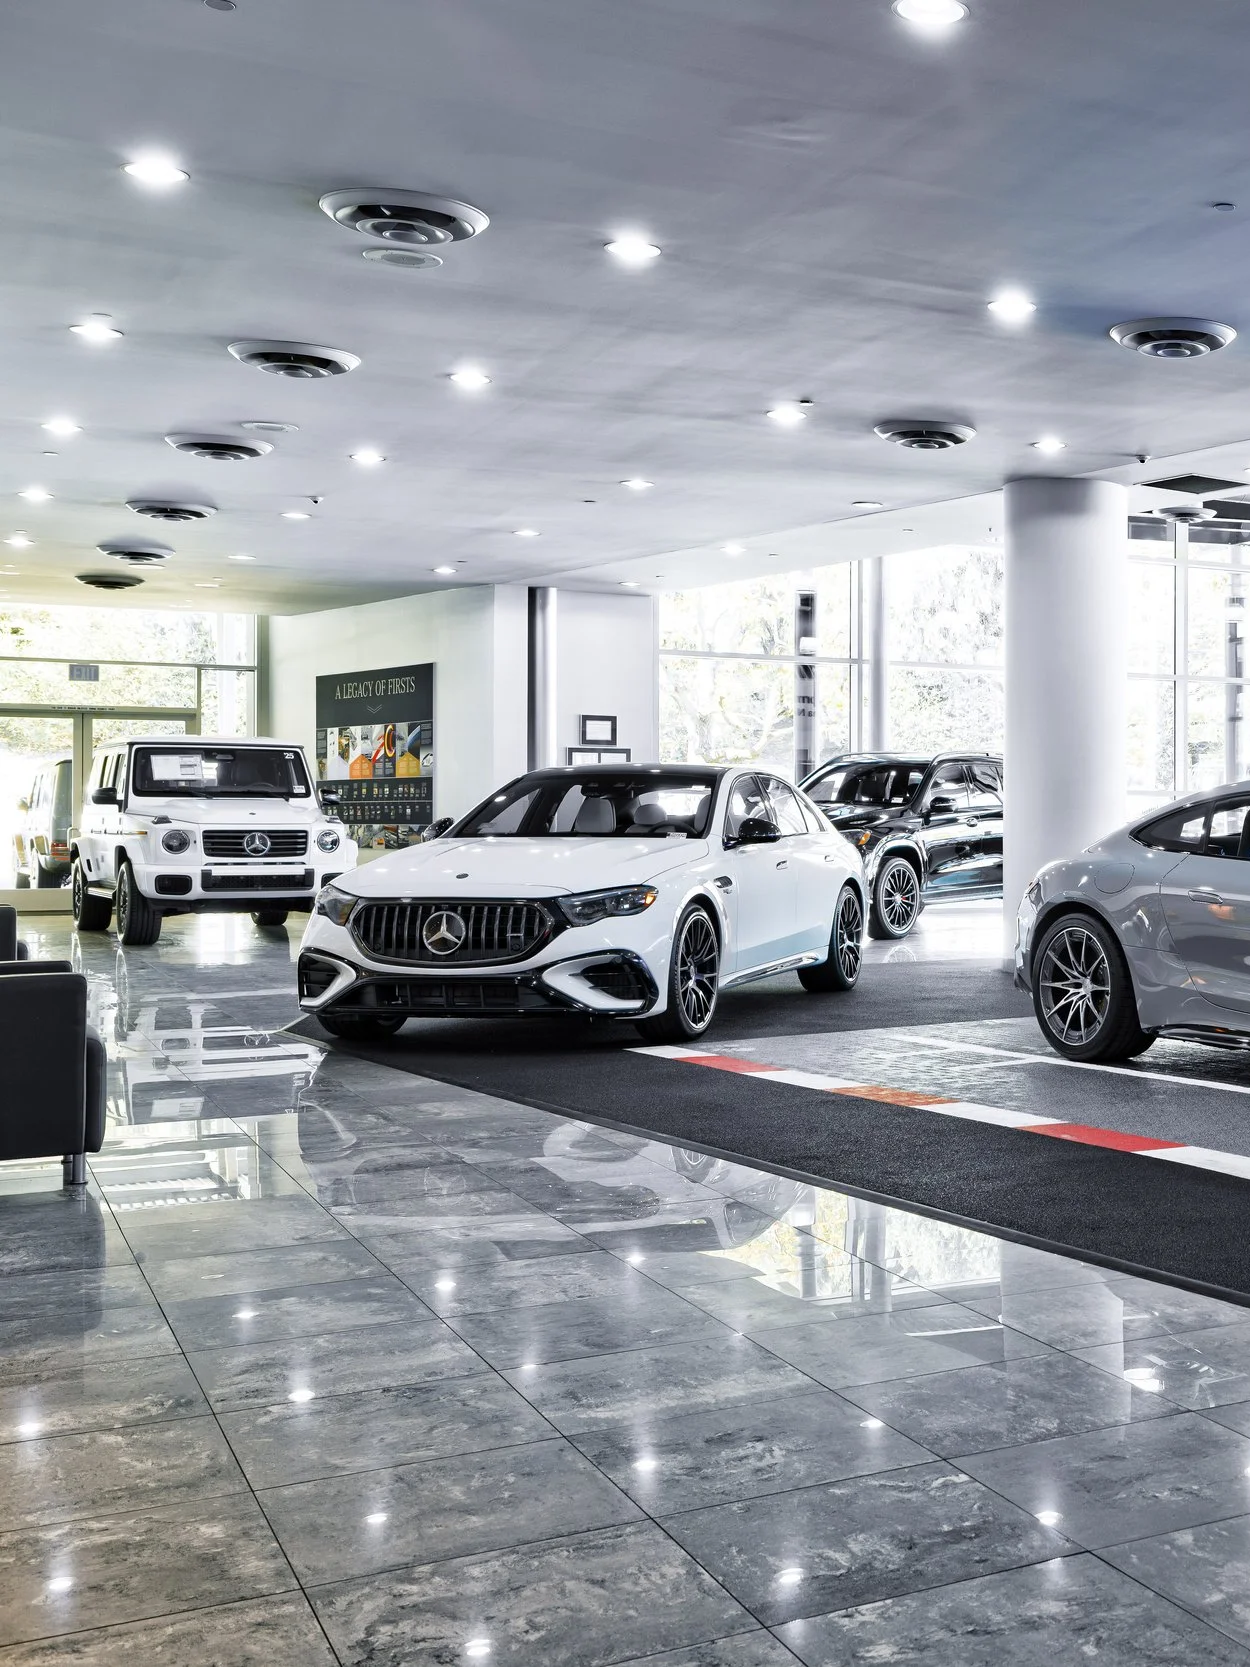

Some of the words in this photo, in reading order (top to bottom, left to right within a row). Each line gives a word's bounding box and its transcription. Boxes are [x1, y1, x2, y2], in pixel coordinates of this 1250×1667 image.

[73, 667, 97, 679] EXIT
[335, 684, 341, 699] A
[343, 681, 373, 699] LEGACY
[375, 680, 386, 696] OF
[388, 676, 415, 695] FIRSTS
